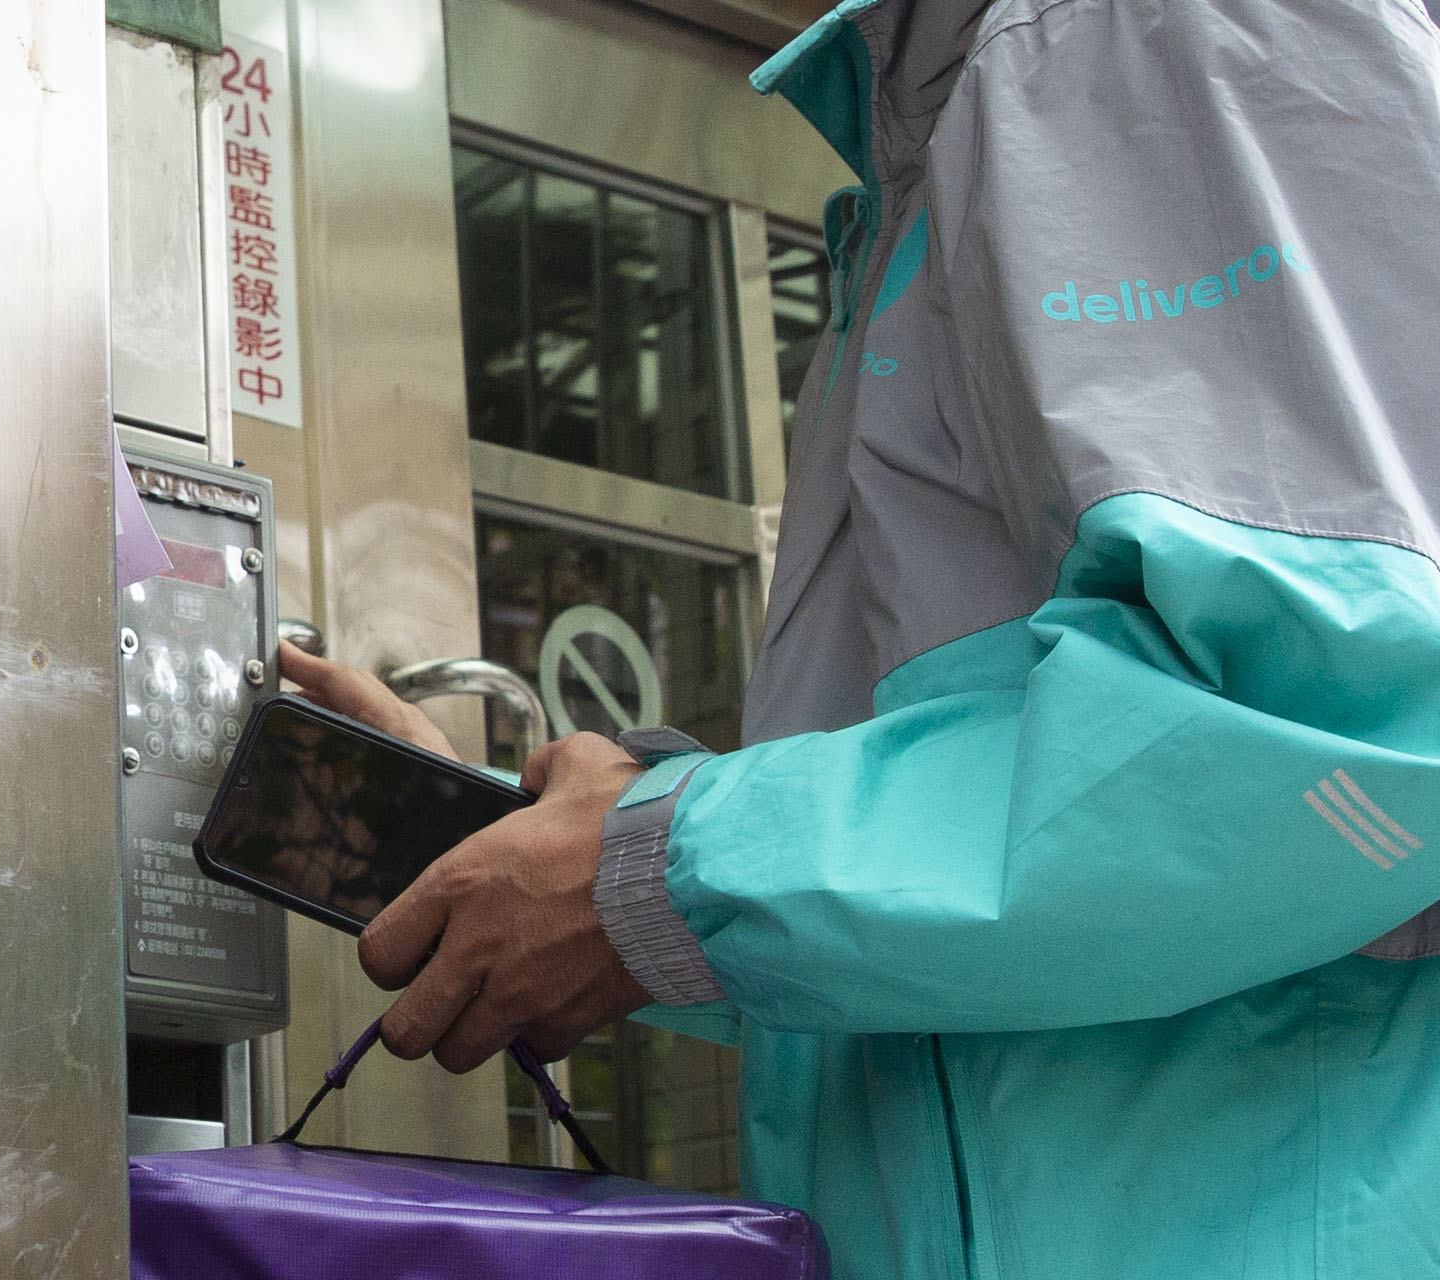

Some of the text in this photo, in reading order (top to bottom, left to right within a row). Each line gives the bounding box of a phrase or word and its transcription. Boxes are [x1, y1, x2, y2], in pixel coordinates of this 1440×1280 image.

[221, 46, 283, 404] 24小時監控錄影中
